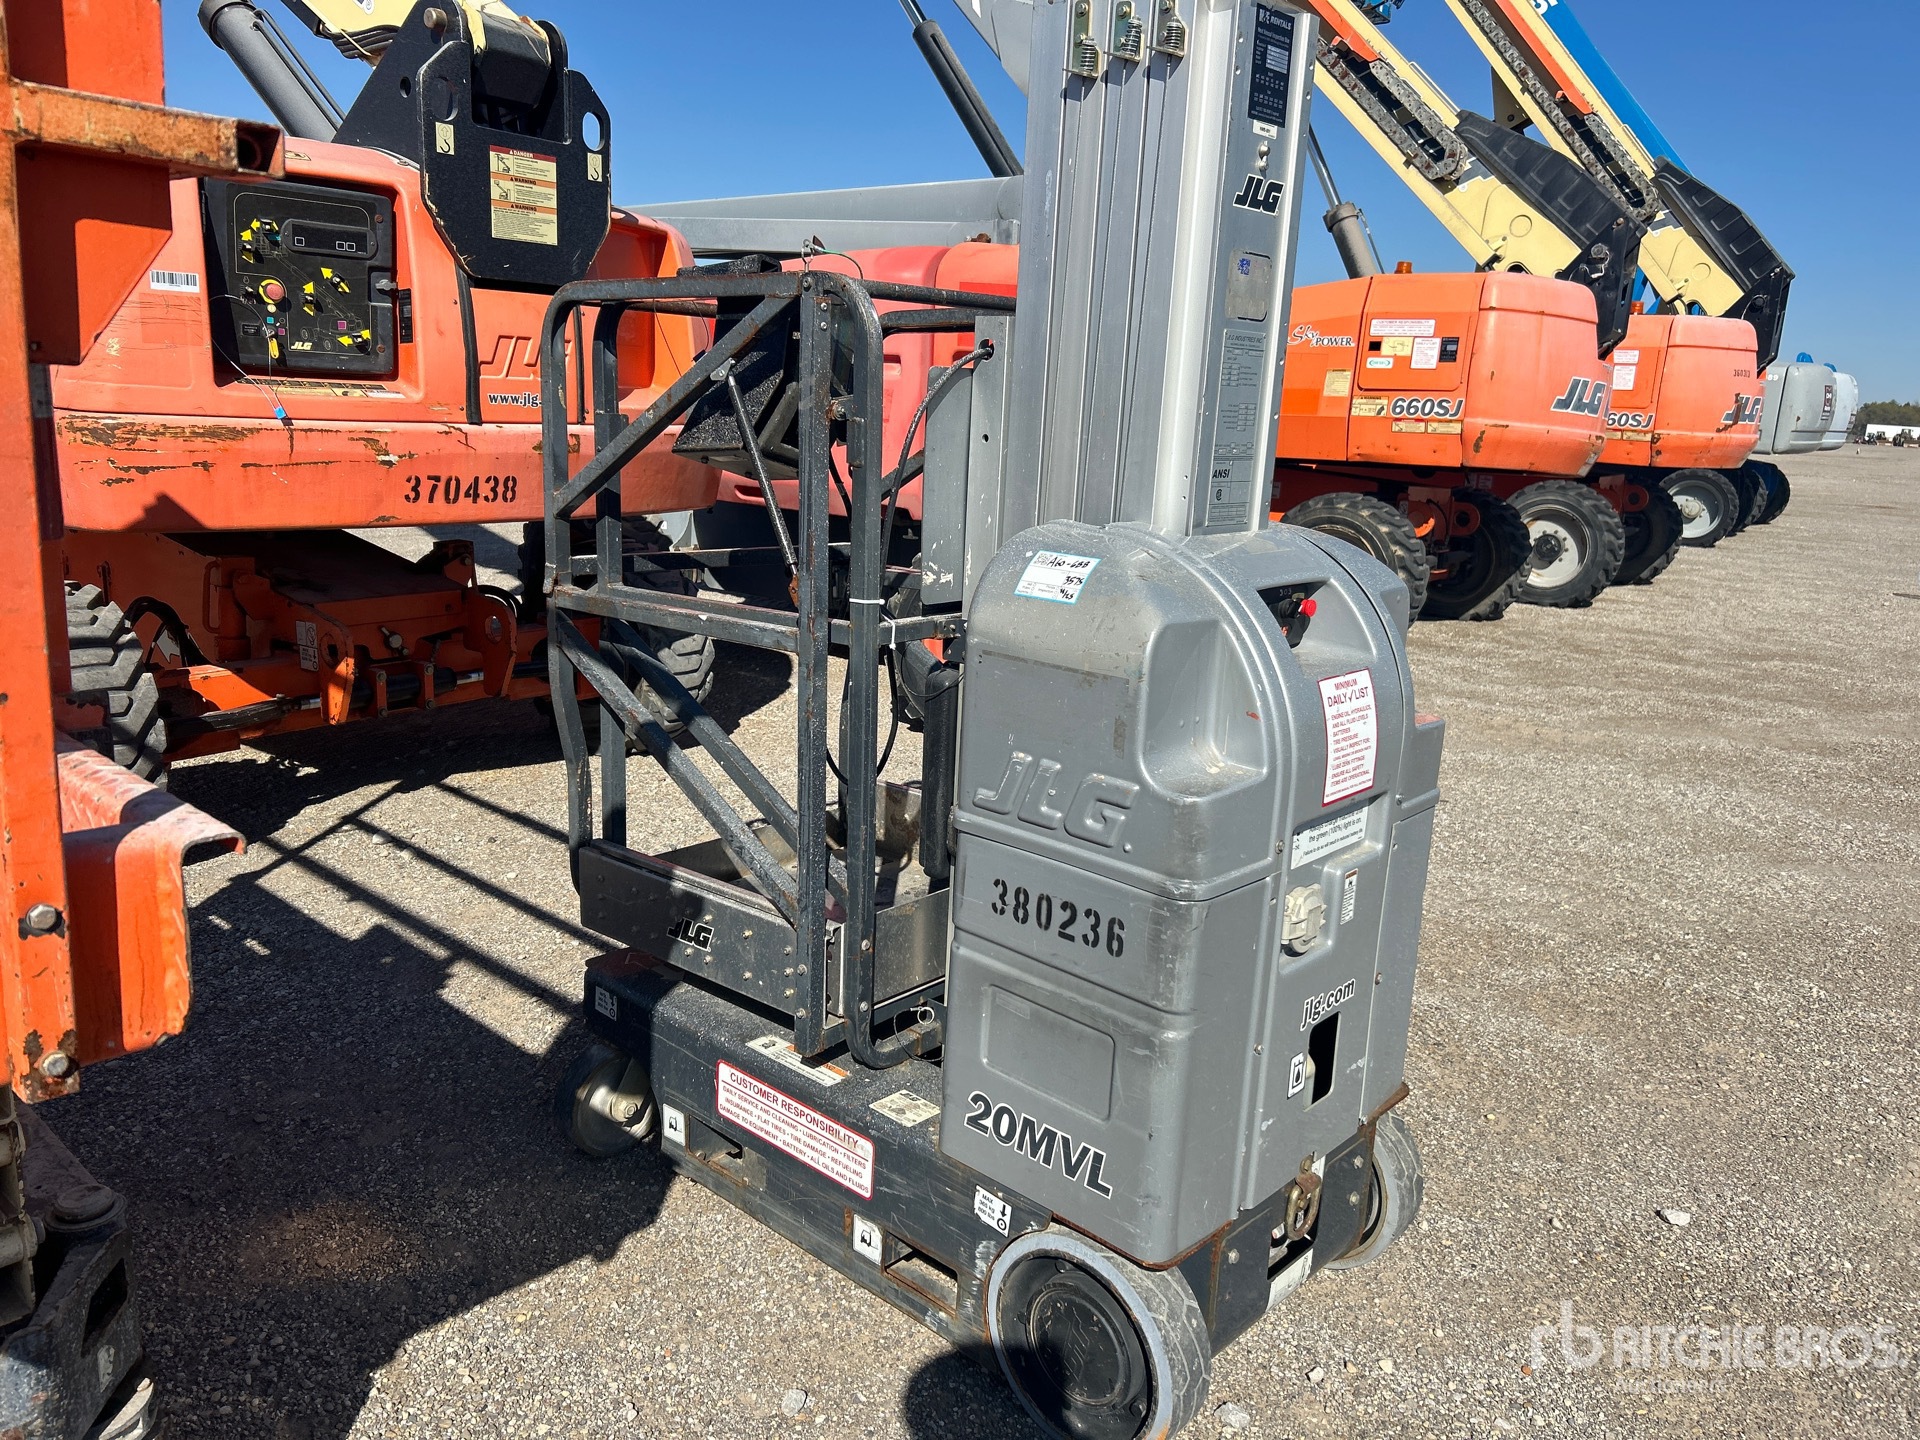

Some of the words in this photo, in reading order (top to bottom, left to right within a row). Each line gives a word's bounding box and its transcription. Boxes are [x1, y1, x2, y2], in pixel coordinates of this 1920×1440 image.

[1271, 16, 1291, 30] RENTALS
[514, 151, 533, 159] DANGER
[1233, 174, 1285, 215] JLG
[291, 342, 313, 350] JLG
[1314, 336, 1353, 346] POWER
[1390, 396, 1465, 418] 660SJ
[1550, 376, 1607, 417] JLG
[1721, 394, 1762, 424] JLG
[1212, 468, 1230, 479] ANSI
[404, 474, 517, 505] 370438
[1334, 678, 1357, 690] MINIMUM
[1327, 692, 1347, 707] DAILY
[1354, 686, 1368, 700] LIST
[1332, 727, 1350, 737] BATTERIES
[1341, 733, 1358, 743] PRESSURE
[1333, 744, 1348, 753] VISUALLY
[1349, 740, 1362, 748] INSPECT
[1351, 763, 1363, 772] SAFETY
[972, 750, 1140, 849] JLG
[1316, 830, 1328, 841] green
[1343, 820, 1351, 830] light
[991, 878, 1126, 958] 380236
[666, 917, 715, 952] JLG
[1301, 979, 1356, 1031] jlg.com
[729, 1071, 778, 1107] CUSTOMER
[781, 1098, 858, 1150] RESPONSIBILITY
[722, 1085, 736, 1099] DAILY
[737, 1093, 758, 1111] SERVICE
[759, 1105, 770, 1118] AND
[771, 1111, 798, 1133] CLEANING
[802, 1128, 838, 1155] LUBRICATION
[843, 1150, 866, 1170] FILTERS
[724, 1096, 753, 1118] INSURANCE
[757, 1114, 769, 1127] FLAT
[771, 1122, 785, 1136] TIRES
[790, 1132, 802, 1145] TIRE
[803, 1139, 826, 1159] DAMAGE
[830, 1154, 862, 1179] REFUELING
[719, 1103, 740, 1122] DAMAGE
[741, 1115, 747, 1126] TO
[748, 1119, 778, 1143] EQUIPMENT
[782, 1138, 805, 1158] BATTERY
[810, 1153, 820, 1166] ALL
[822, 1160, 834, 1174] OILS
[835, 1167, 847, 1182] AND
[848, 1175, 868, 1193] FLUIDS
[964, 1091, 1113, 1200] 20MVL
[982, 1194, 993, 1204] MAX
